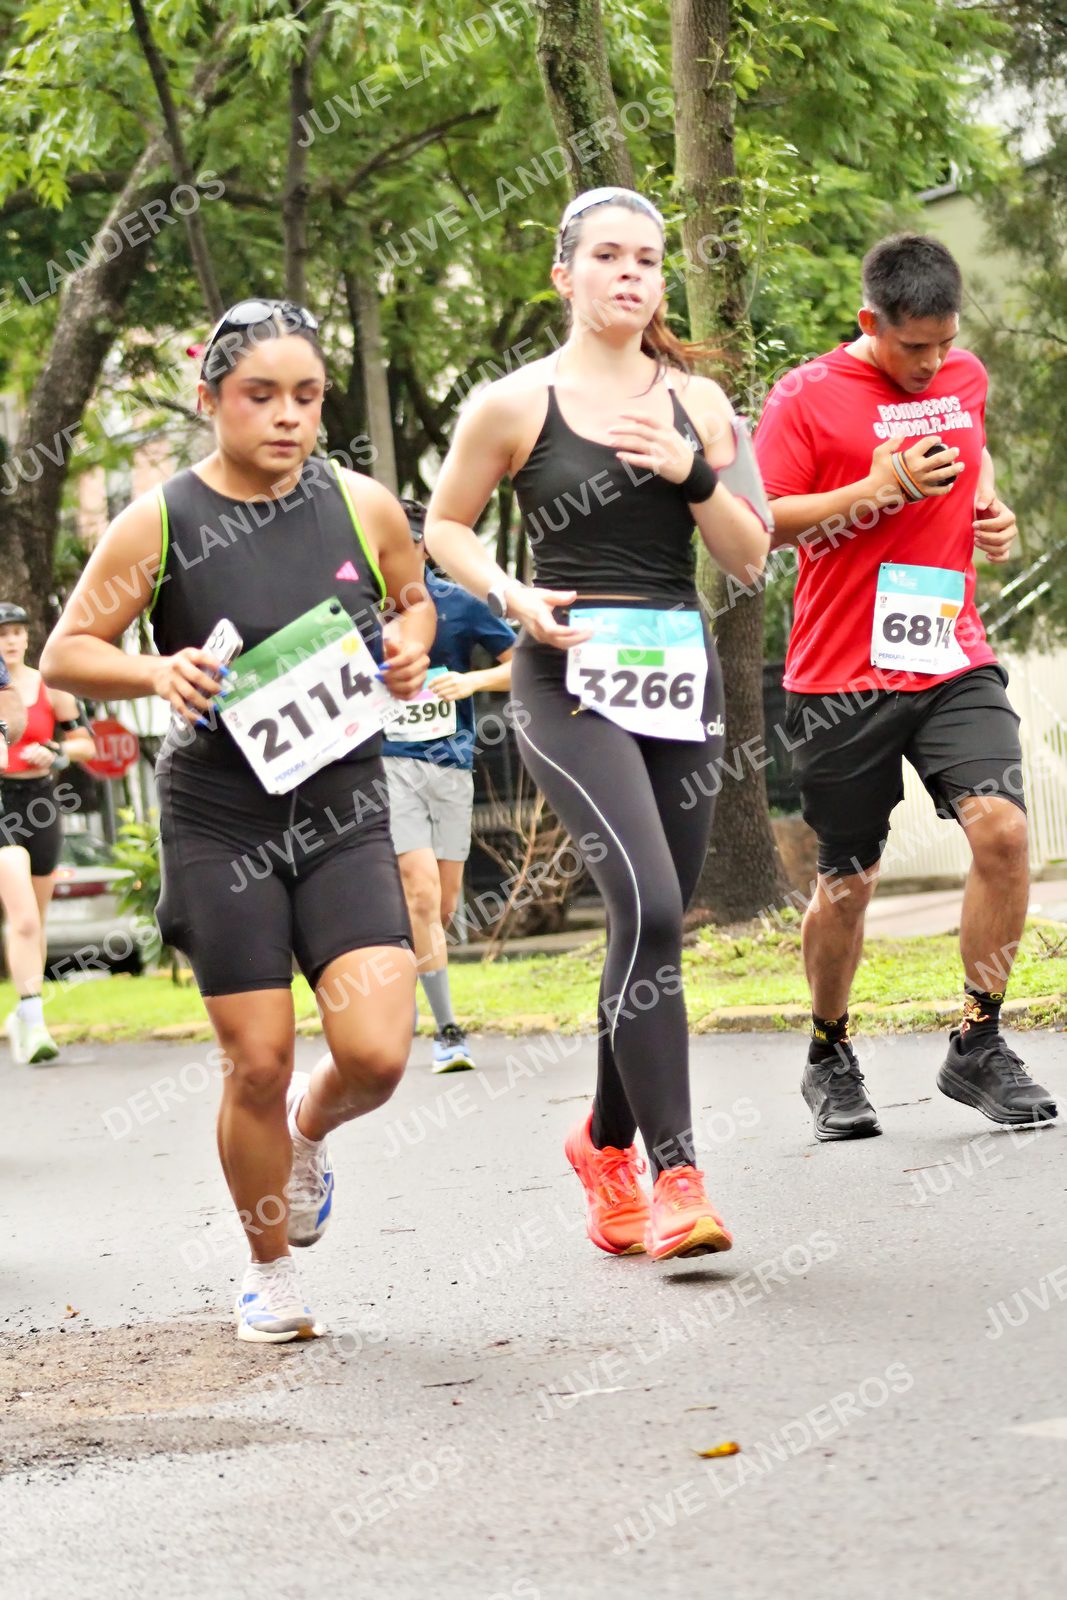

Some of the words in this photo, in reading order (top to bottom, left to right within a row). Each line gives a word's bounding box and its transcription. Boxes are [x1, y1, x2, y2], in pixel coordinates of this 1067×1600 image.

[877, 396, 960, 421] BOMBEROS
[579, 668, 696, 710] 3266
[248, 662, 374, 764] 2114
